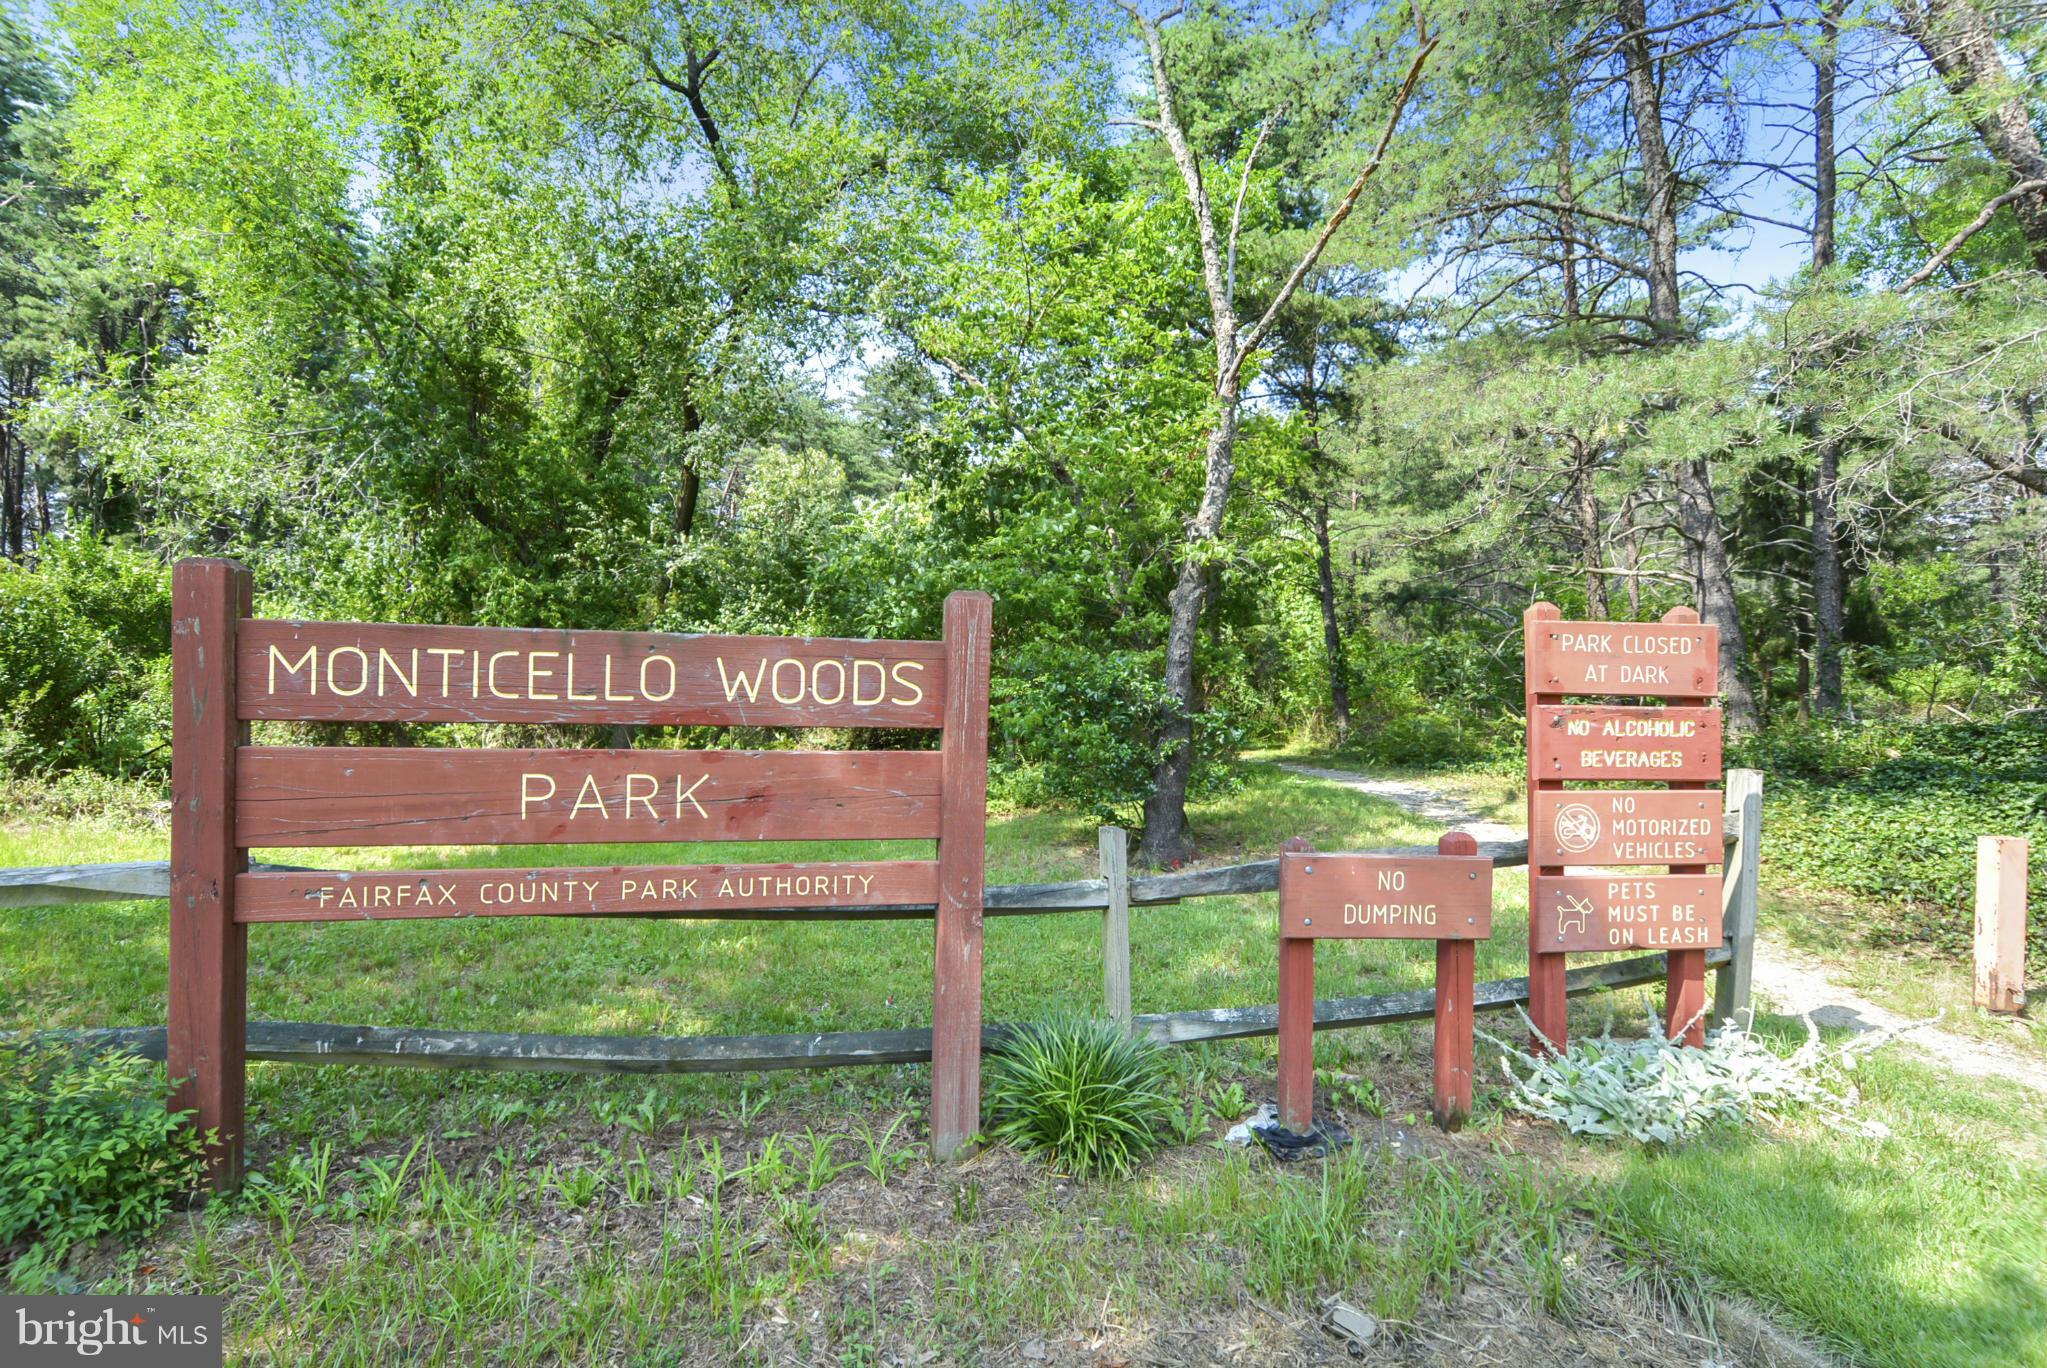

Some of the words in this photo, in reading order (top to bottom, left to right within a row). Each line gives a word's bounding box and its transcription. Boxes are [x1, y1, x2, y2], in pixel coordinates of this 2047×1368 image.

[1561, 634, 1612, 653] PARK
[1623, 635, 1692, 655] CLOSED
[267, 644, 677, 702] MONTICELLO
[715, 656, 924, 707] WOODS
[1585, 665, 1608, 682] AT
[1620, 666, 1669, 684] DARK
[1567, 720, 1590, 736] NO
[1603, 720, 1696, 737] ALCOHOLIC
[1580, 750, 1683, 768] BEVERAGES
[521, 772, 711, 820] PARK
[1612, 797, 1635, 813] NO
[1612, 819, 1711, 836] MOTORIZED
[1612, 842, 1695, 859] VEHICLES
[1378, 871, 1405, 891] NO
[319, 883, 457, 909] FAIRFAX
[479, 880, 600, 904] COUNTY
[621, 877, 699, 900] PARK
[718, 873, 875, 897] AUTHORITY
[1608, 883, 1656, 899] PETS
[1344, 904, 1437, 925] DUMPING
[1608, 906, 1660, 922] MUST
[1672, 906, 1694, 922] BE
[1609, 928, 1636, 945] ON
[1648, 928, 1708, 944] LEASH
